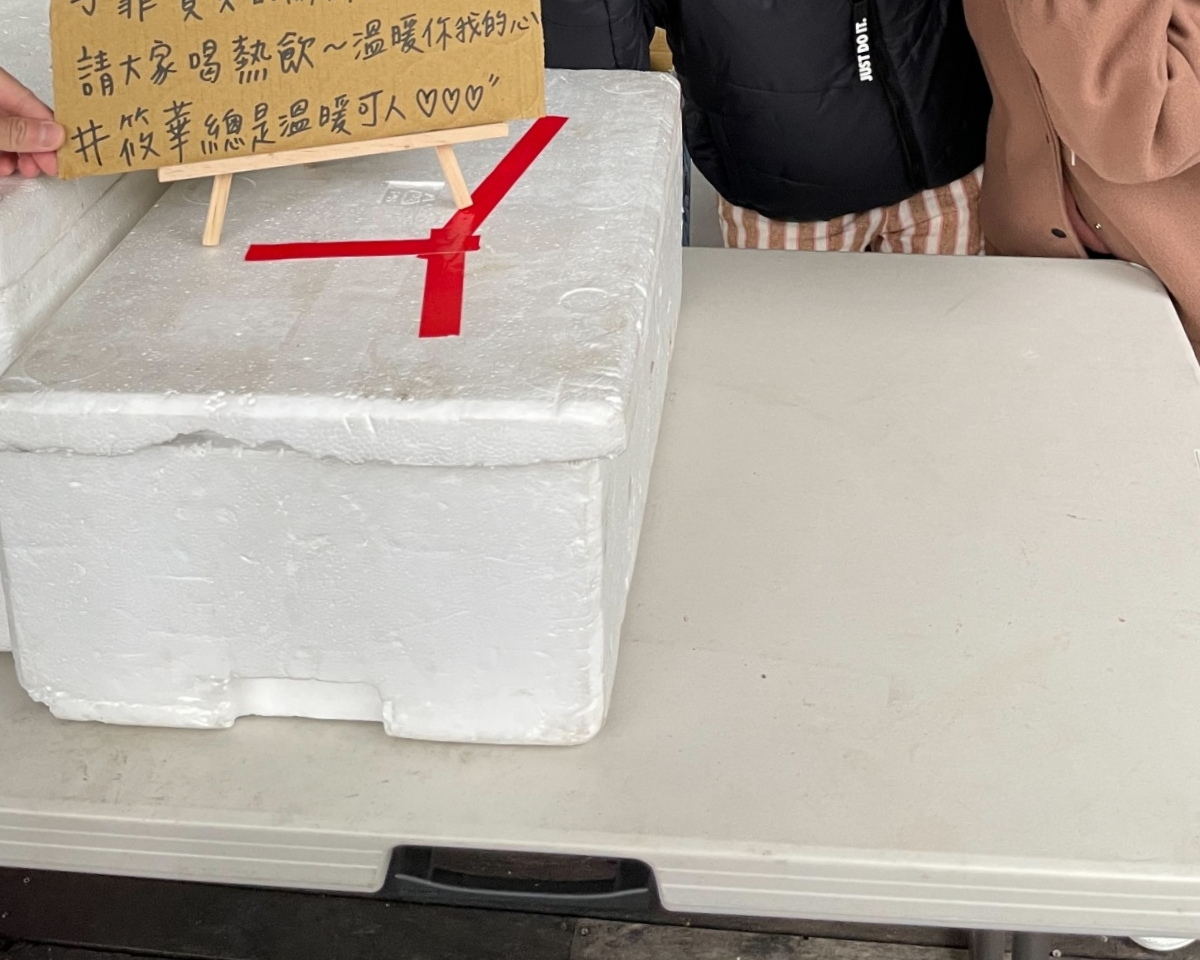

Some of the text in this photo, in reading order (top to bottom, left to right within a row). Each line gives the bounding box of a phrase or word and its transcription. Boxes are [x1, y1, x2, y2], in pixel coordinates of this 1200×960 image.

[855, 17, 873, 82] JUST DO IT.
